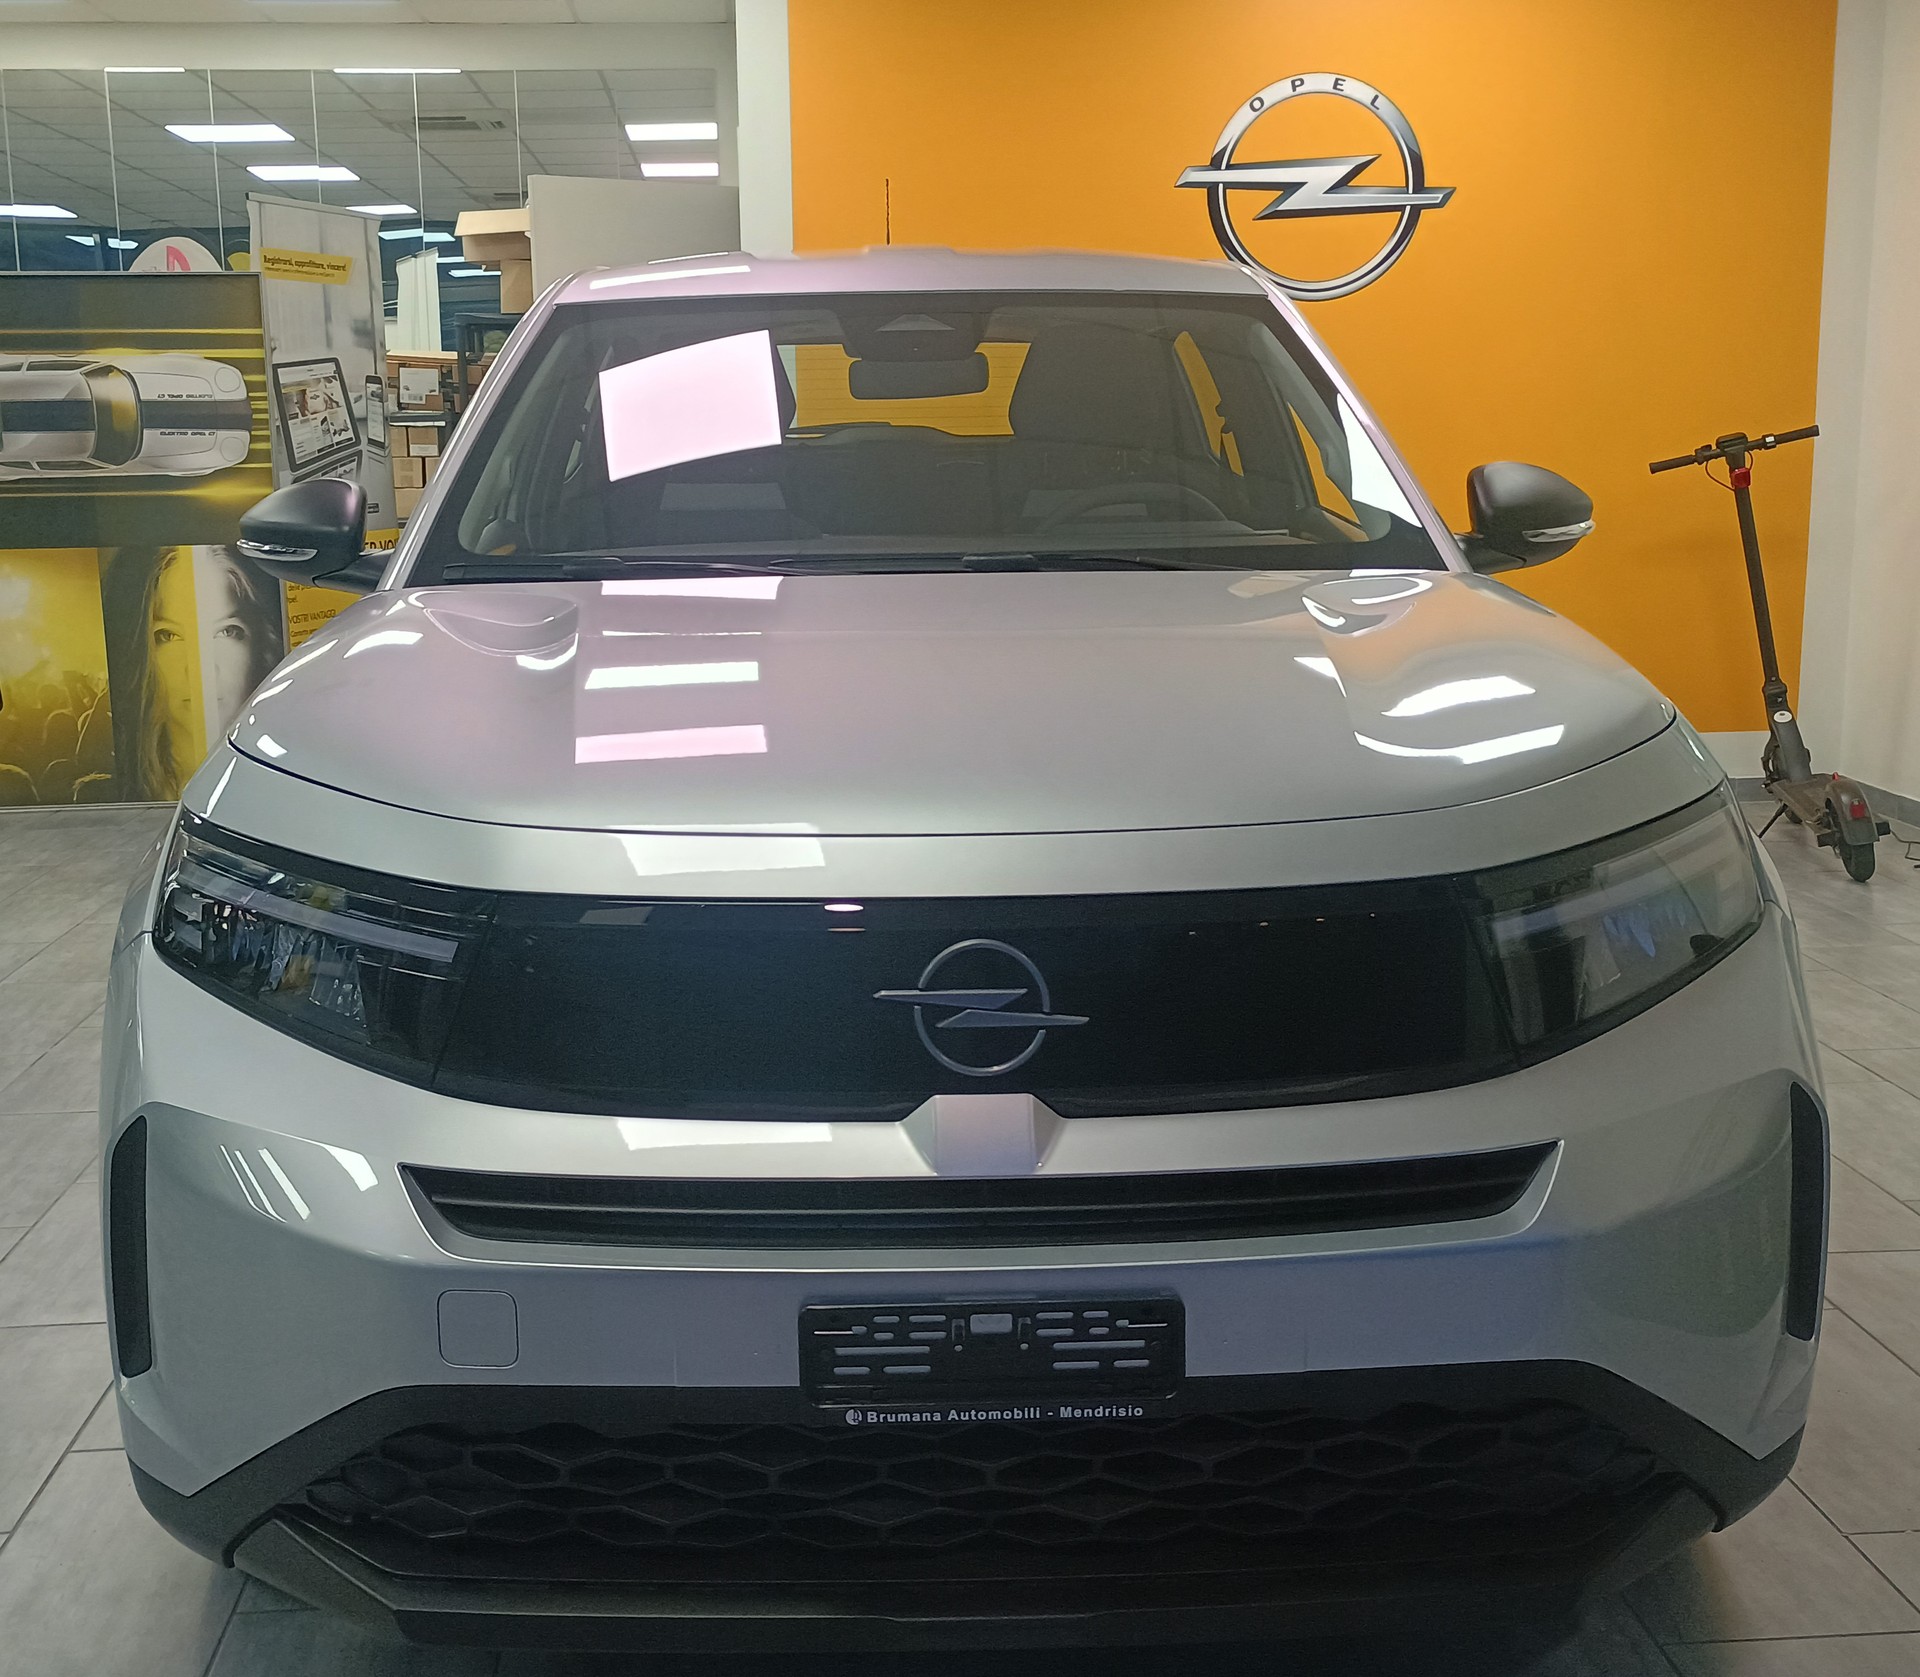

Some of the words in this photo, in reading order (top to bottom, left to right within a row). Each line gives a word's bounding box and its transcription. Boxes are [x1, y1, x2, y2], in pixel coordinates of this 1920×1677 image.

[1249, 77, 1380, 112] OPEL
[866, 1411, 941, 1423] Brumana
[947, 1407, 1040, 1421] Automobili
[1060, 1405, 1144, 1418] Mendrisio
